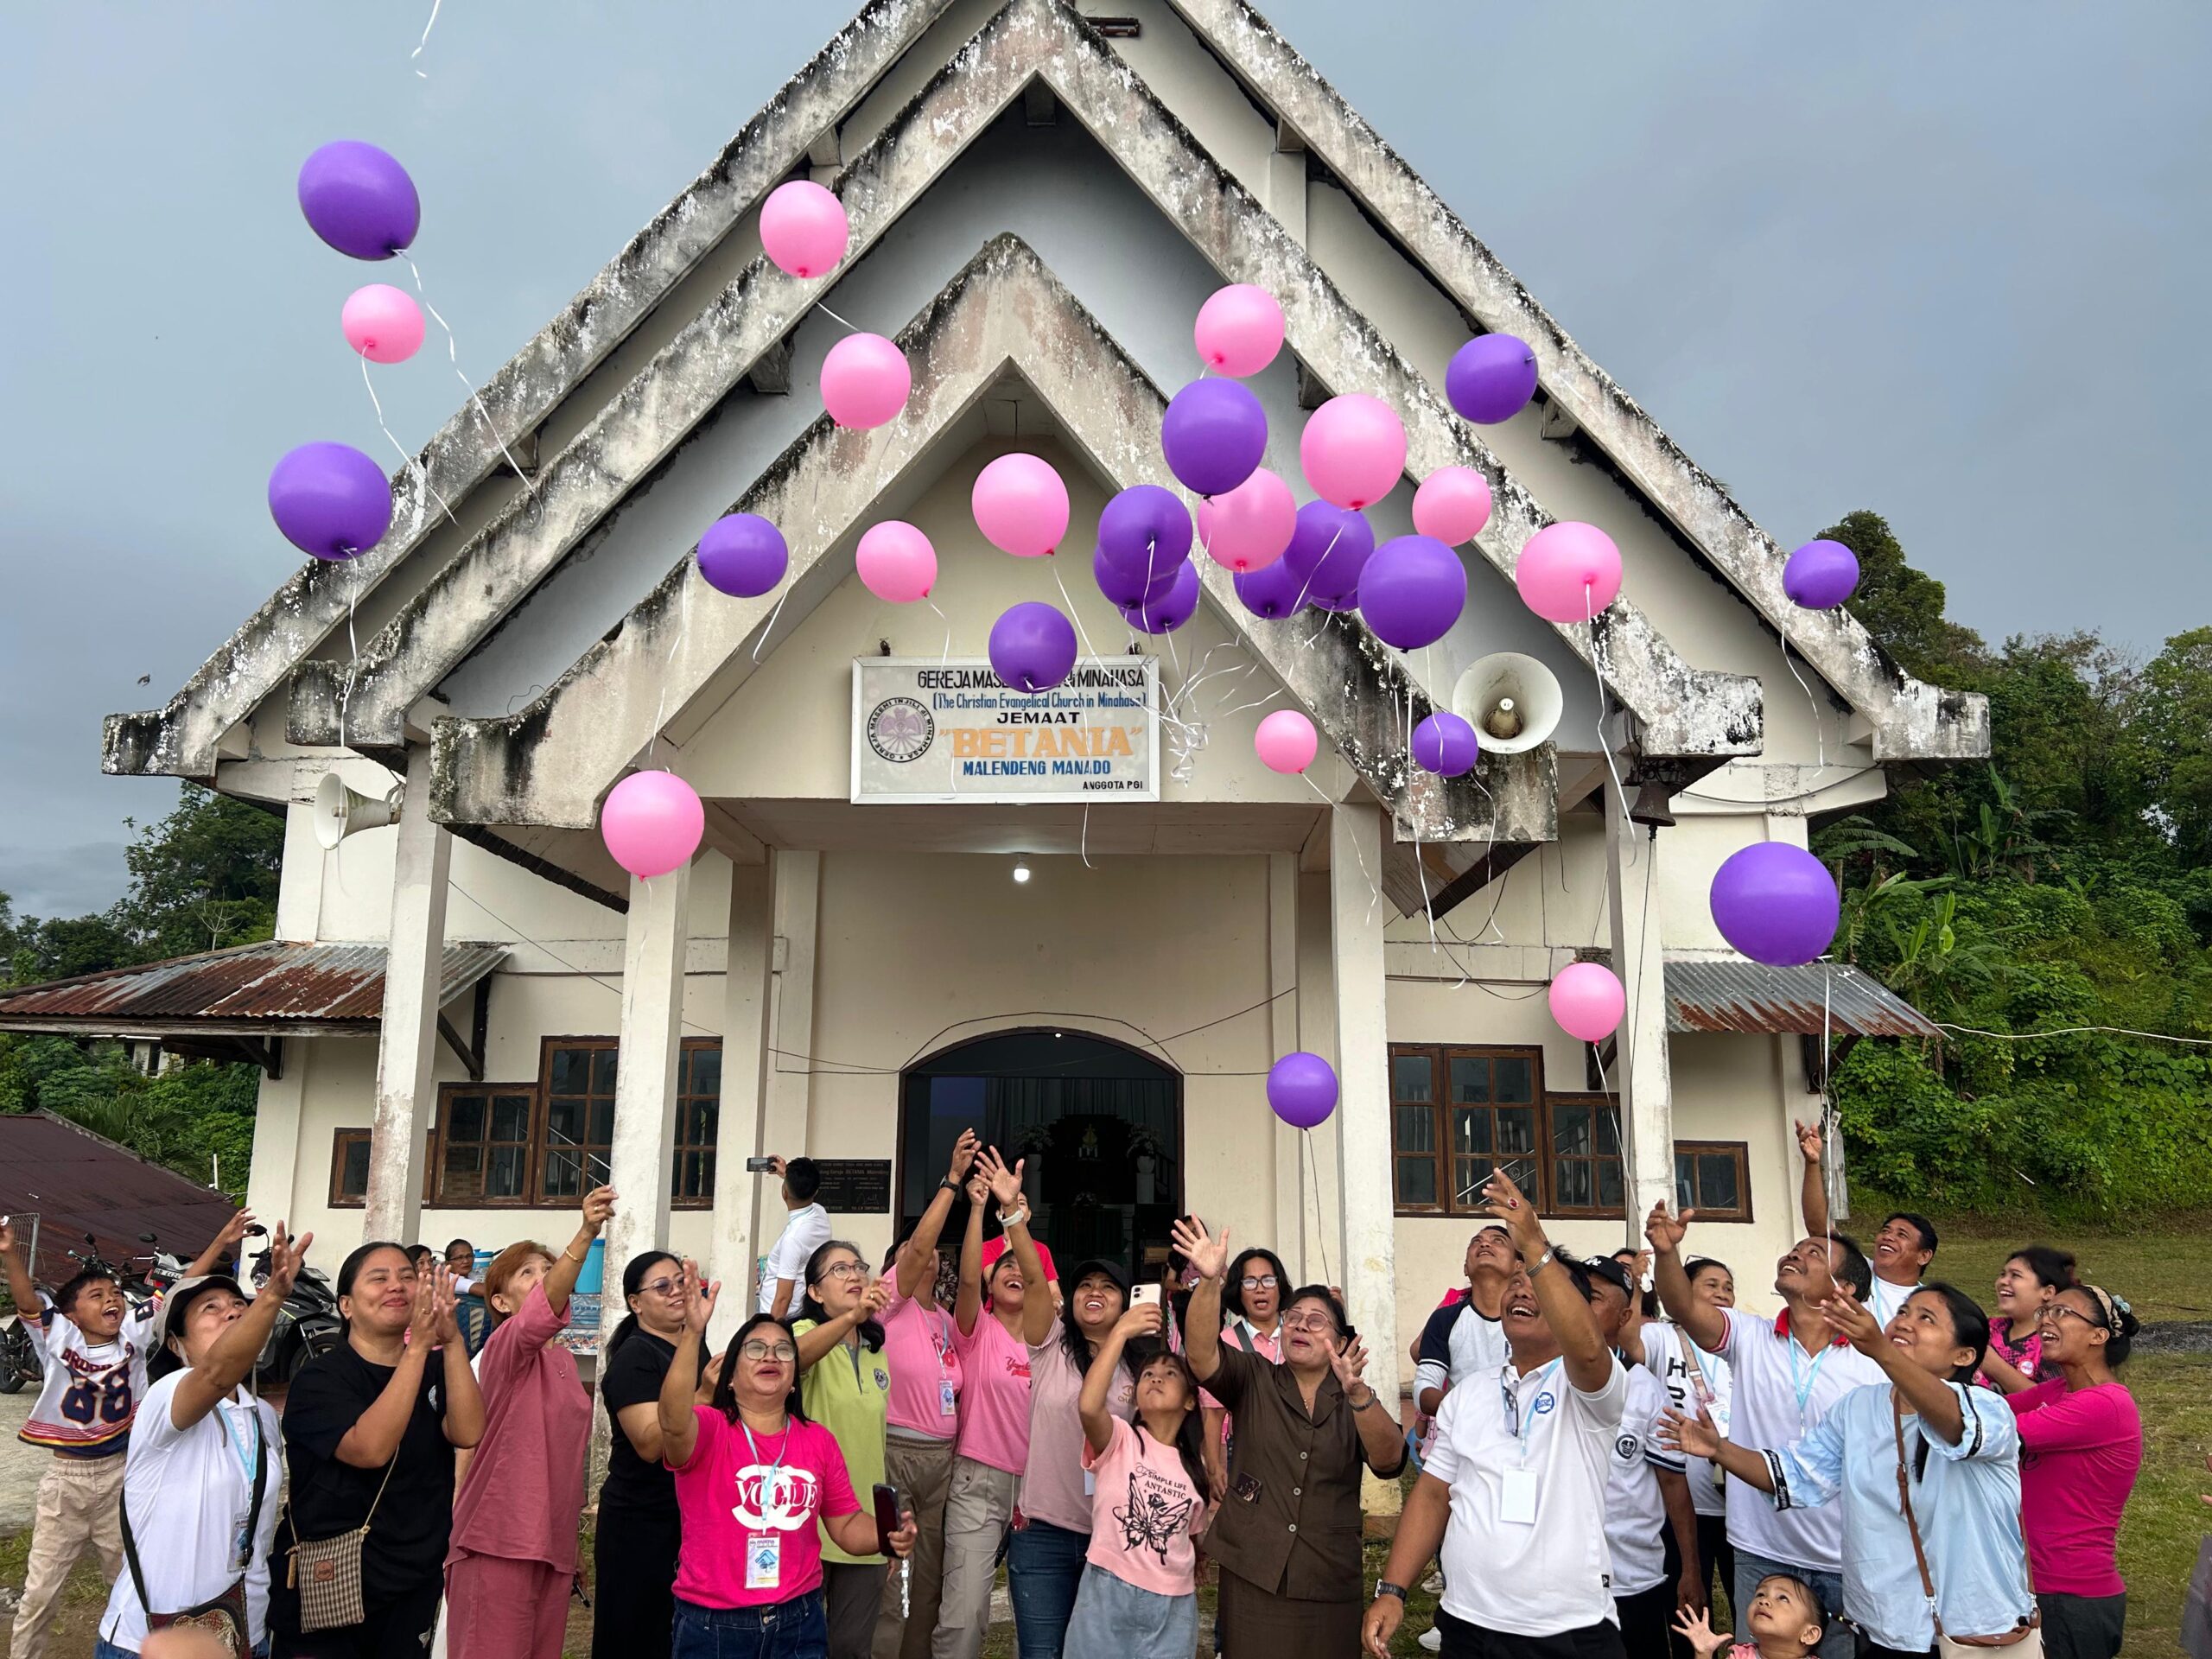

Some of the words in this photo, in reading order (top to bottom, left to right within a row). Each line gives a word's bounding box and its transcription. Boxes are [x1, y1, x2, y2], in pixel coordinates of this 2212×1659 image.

[918, 671, 973, 689] GEREJA
[973, 671, 1010, 689] MAS
[1077, 670, 1145, 688] MINAHASA
[957, 693, 997, 709] Christian
[1000, 692, 1050, 711] Evangelical
[1052, 691, 1084, 709] Church
[1086, 694, 1094, 708] in
[997, 712, 1080, 724] JEMAAT
[963, 760, 1046, 776] MALENDENG
[1052, 760, 1111, 775] MANADO
[1083, 780, 1124, 791] ANGGOTA
[1127, 780, 1143, 790] PGI
[1147, 1471, 1173, 1487] SIMPLE
[1173, 1482, 1187, 1491] LIFE
[734, 1480, 817, 1509] VOGUE
